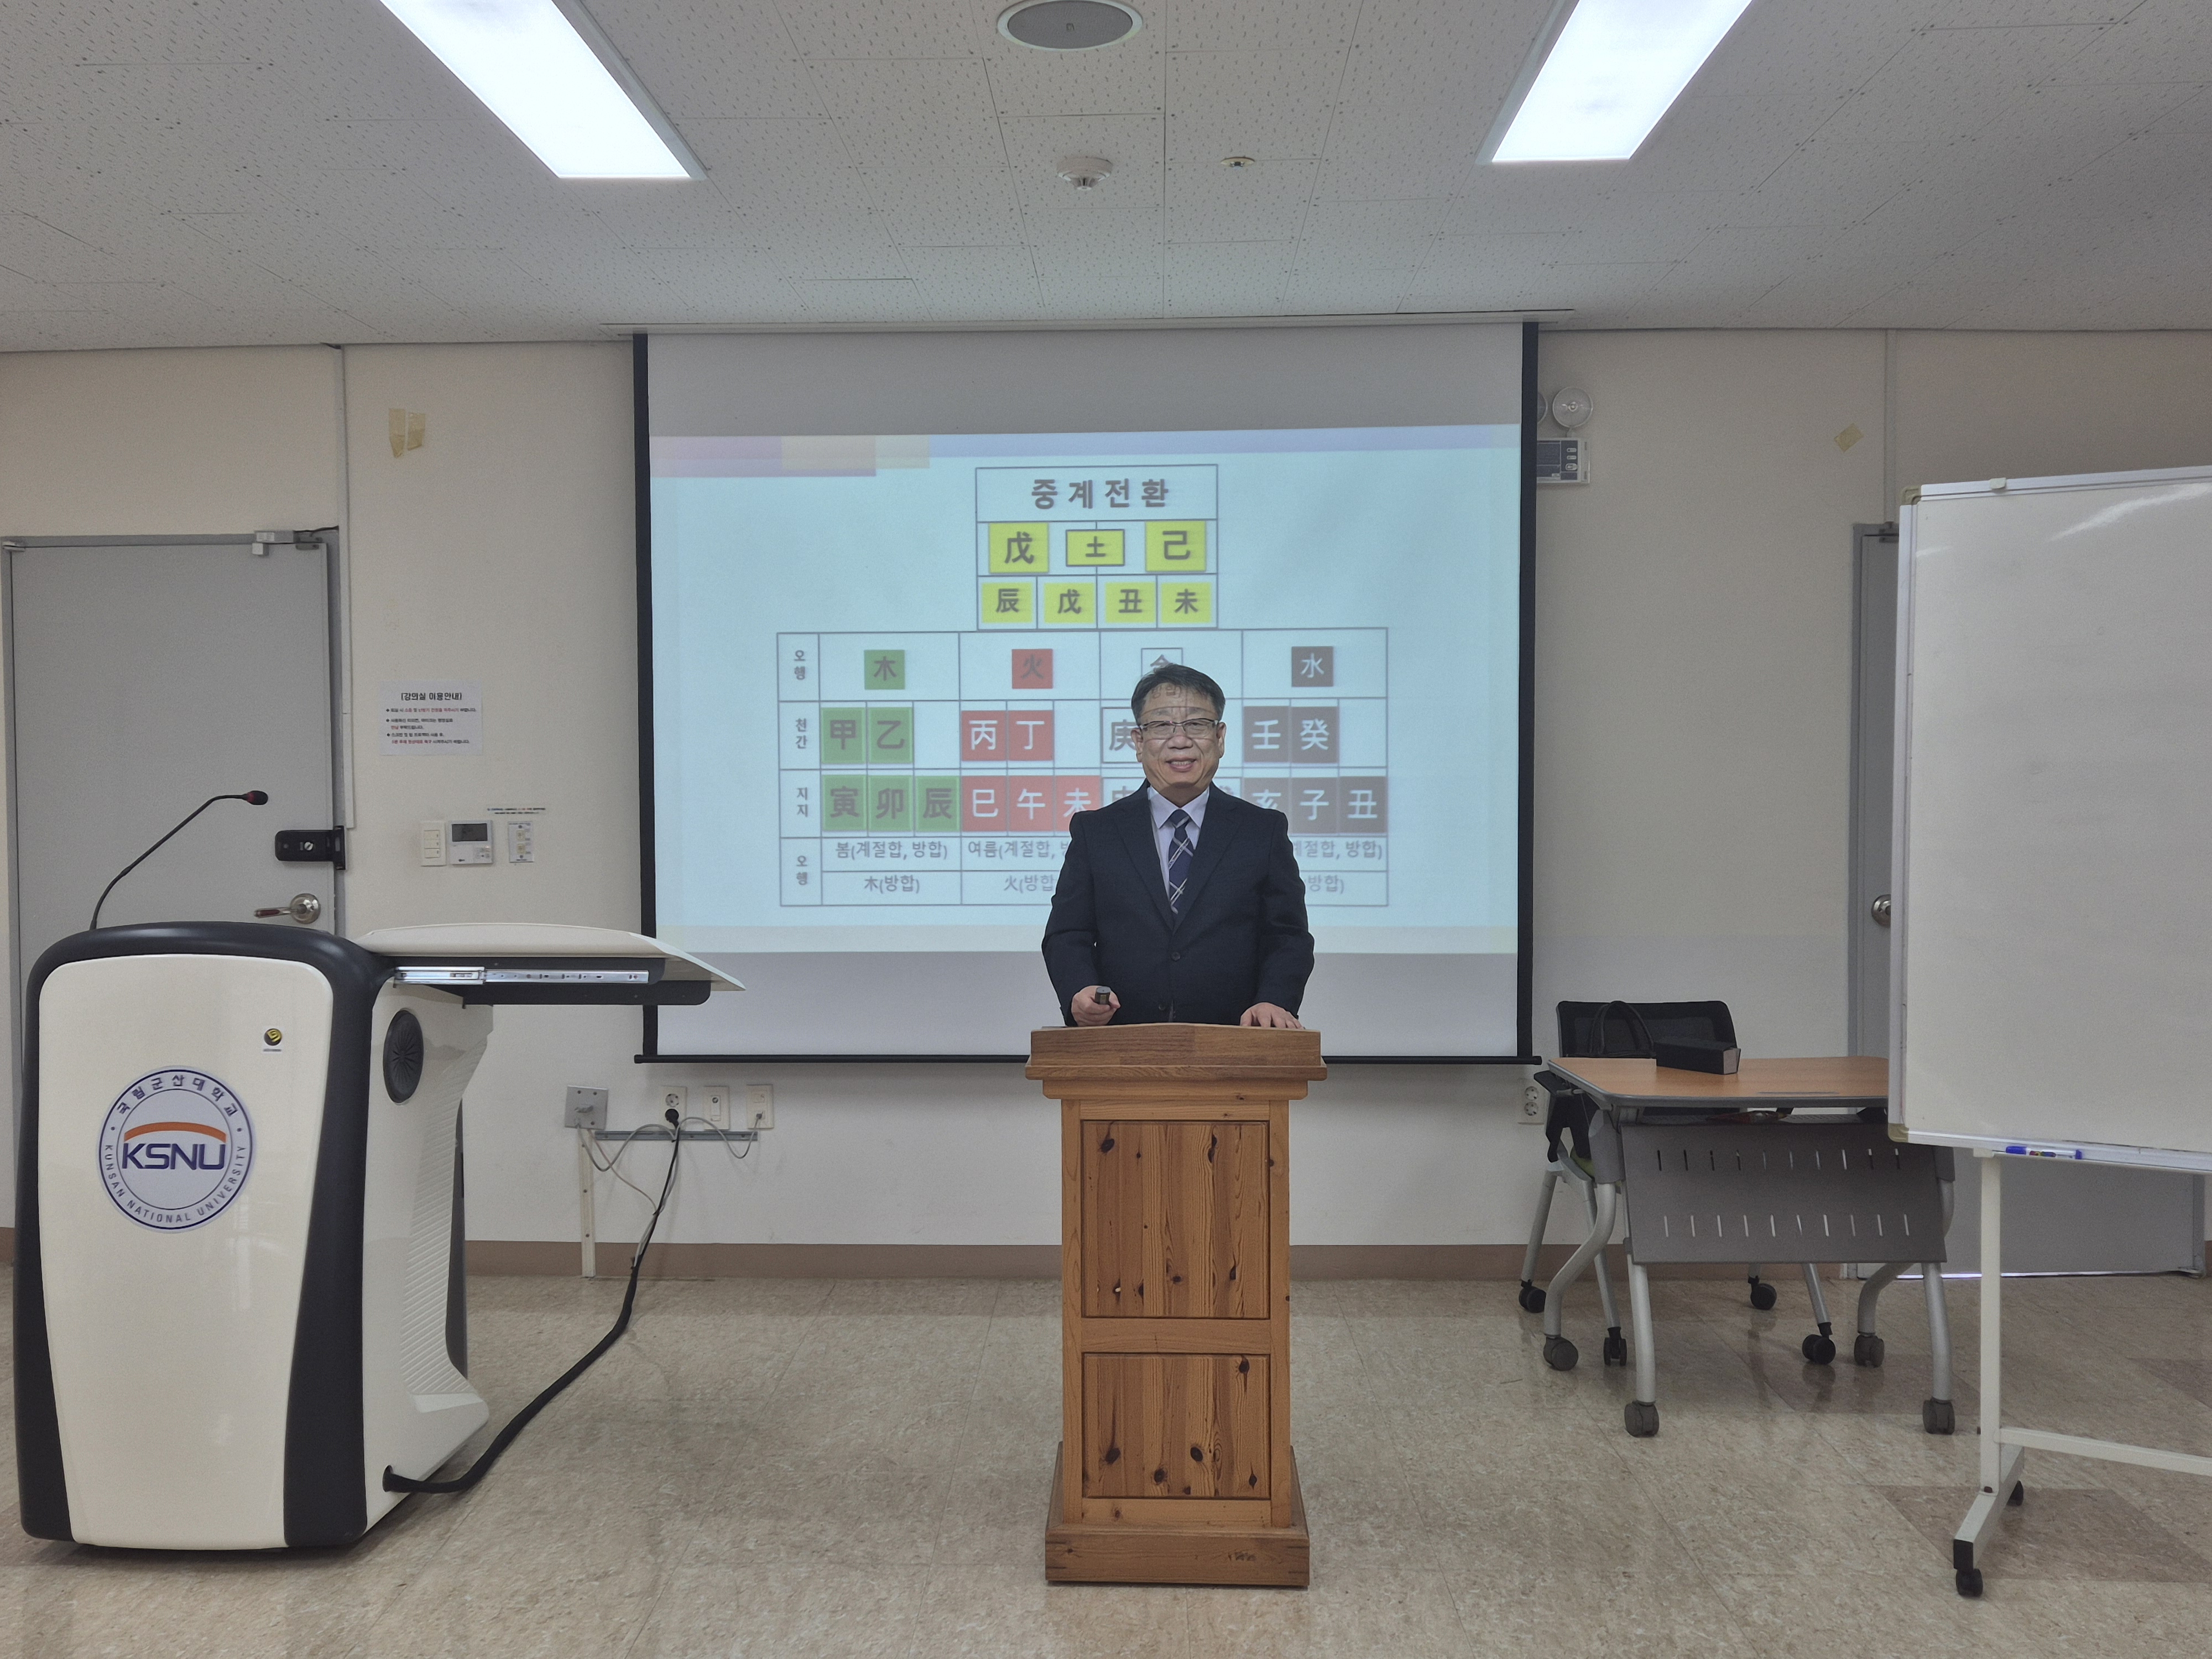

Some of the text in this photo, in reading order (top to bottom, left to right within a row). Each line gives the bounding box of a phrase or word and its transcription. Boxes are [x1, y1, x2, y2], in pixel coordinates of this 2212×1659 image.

[1031, 478, 1169, 509] 중계전환
[1004, 530, 1191, 564] 戊 土 己
[996, 588, 1020, 613] 辰
[1118, 589, 1142, 613] 丑
[1174, 588, 1199, 614] 未
[873, 655, 897, 681] 木
[1021, 654, 1045, 680] 火
[1300, 653, 1325, 679] 水
[829, 719, 905, 750] 甲 乙
[969, 719, 1045, 750] 丙 丁
[1251, 718, 1330, 750] 壬 癸
[830, 786, 953, 820] 寅 卯 辰
[1016, 788, 1046, 820] 午
[1300, 790, 1329, 820] 子
[1347, 790, 1378, 820] 丑
[912, 841, 948, 860] 방합)
[1346, 841, 1382, 860] 방합)
[117, 1074, 238, 1117] 국립군산대학교
[122, 1142, 226, 1170] KSNU
[105, 1144, 246, 1223] KUNSAN NATIONAL UNIVERSITY
